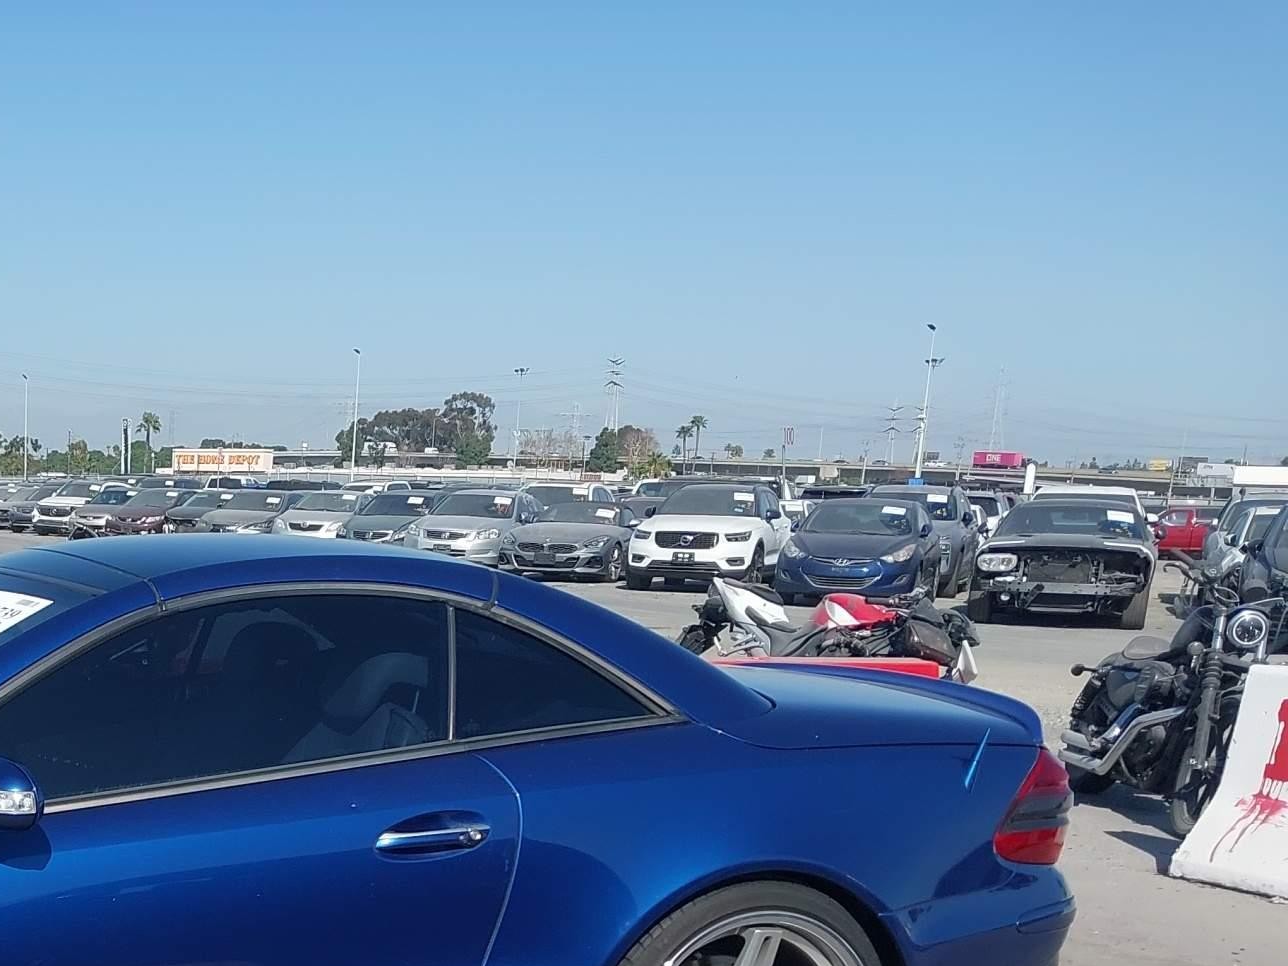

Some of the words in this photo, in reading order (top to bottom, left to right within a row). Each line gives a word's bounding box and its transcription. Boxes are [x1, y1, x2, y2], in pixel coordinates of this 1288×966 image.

[783, 427, 794, 445] 100
[176, 454, 195, 465] THE
[198, 454, 225, 465] HOME
[228, 454, 261, 465] DEPOT
[985, 453, 1001, 462] ONE
